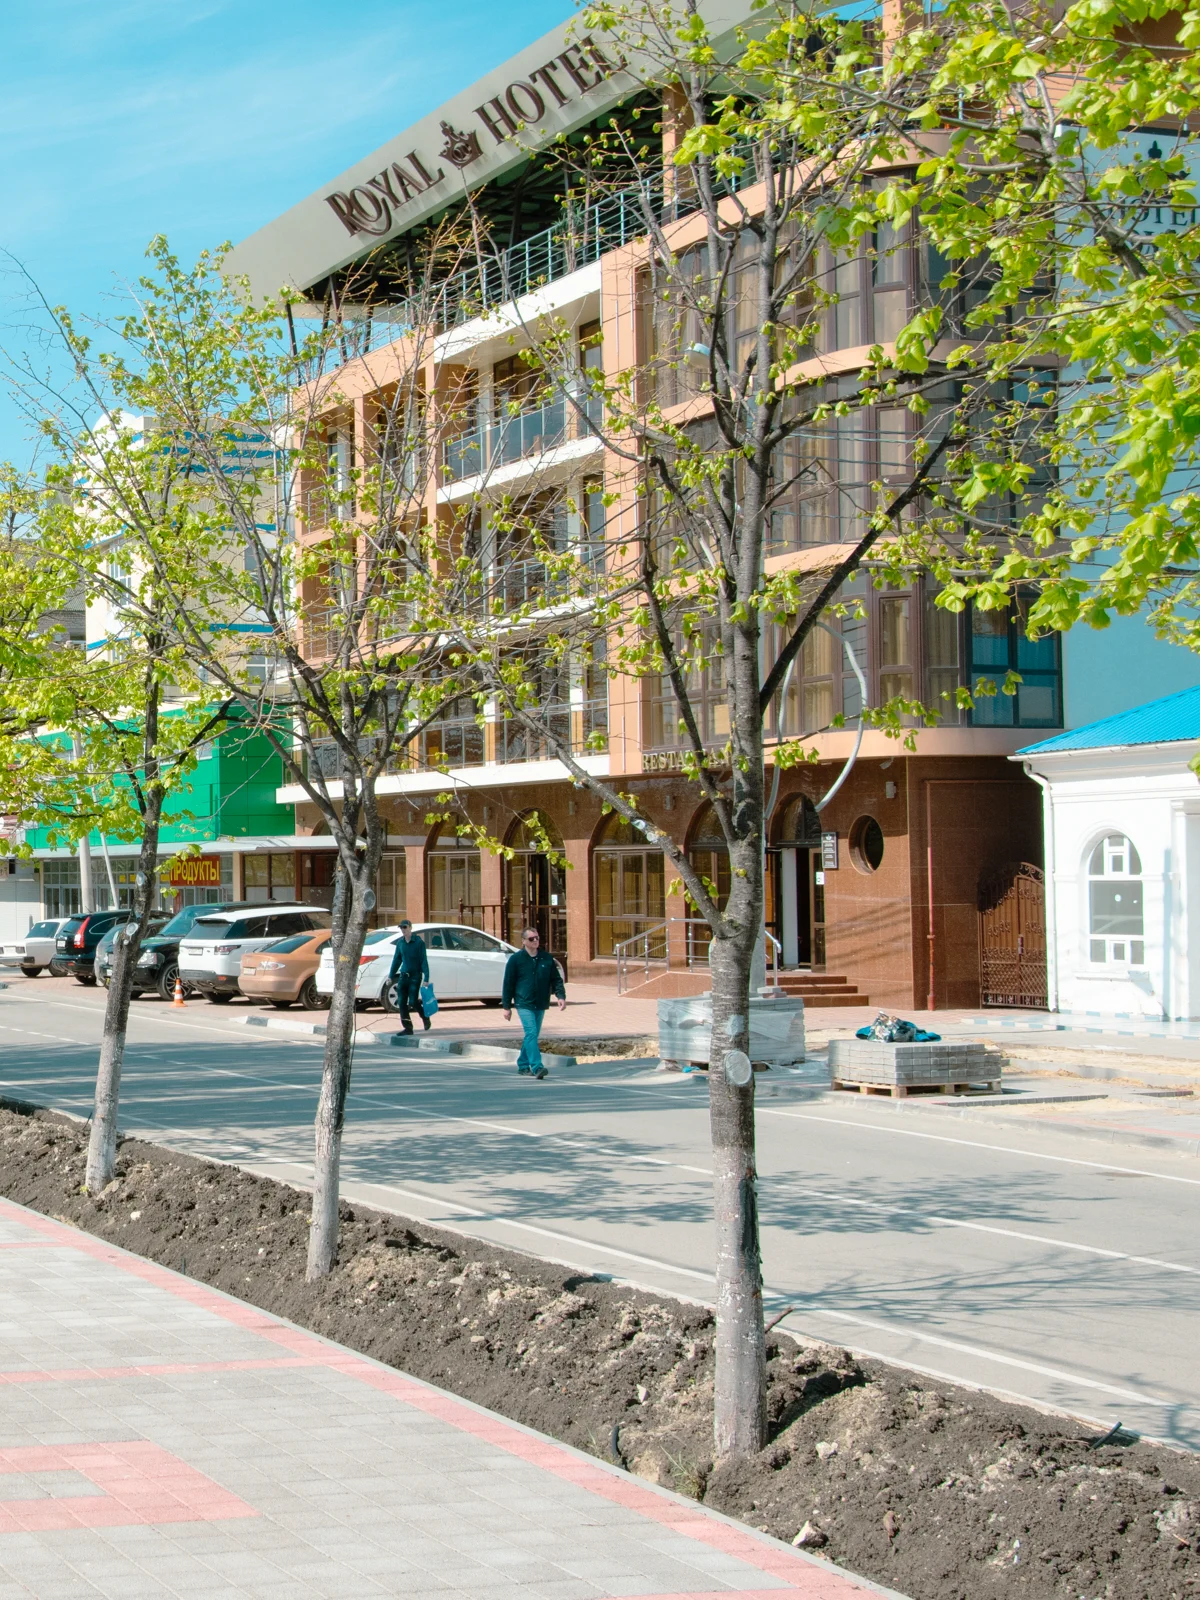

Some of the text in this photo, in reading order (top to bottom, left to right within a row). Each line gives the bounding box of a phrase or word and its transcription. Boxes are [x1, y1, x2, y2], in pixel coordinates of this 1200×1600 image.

[323, 35, 628, 238] ROYAL HOTEL
[170, 860, 220, 885] ПРОДУКТЫ
